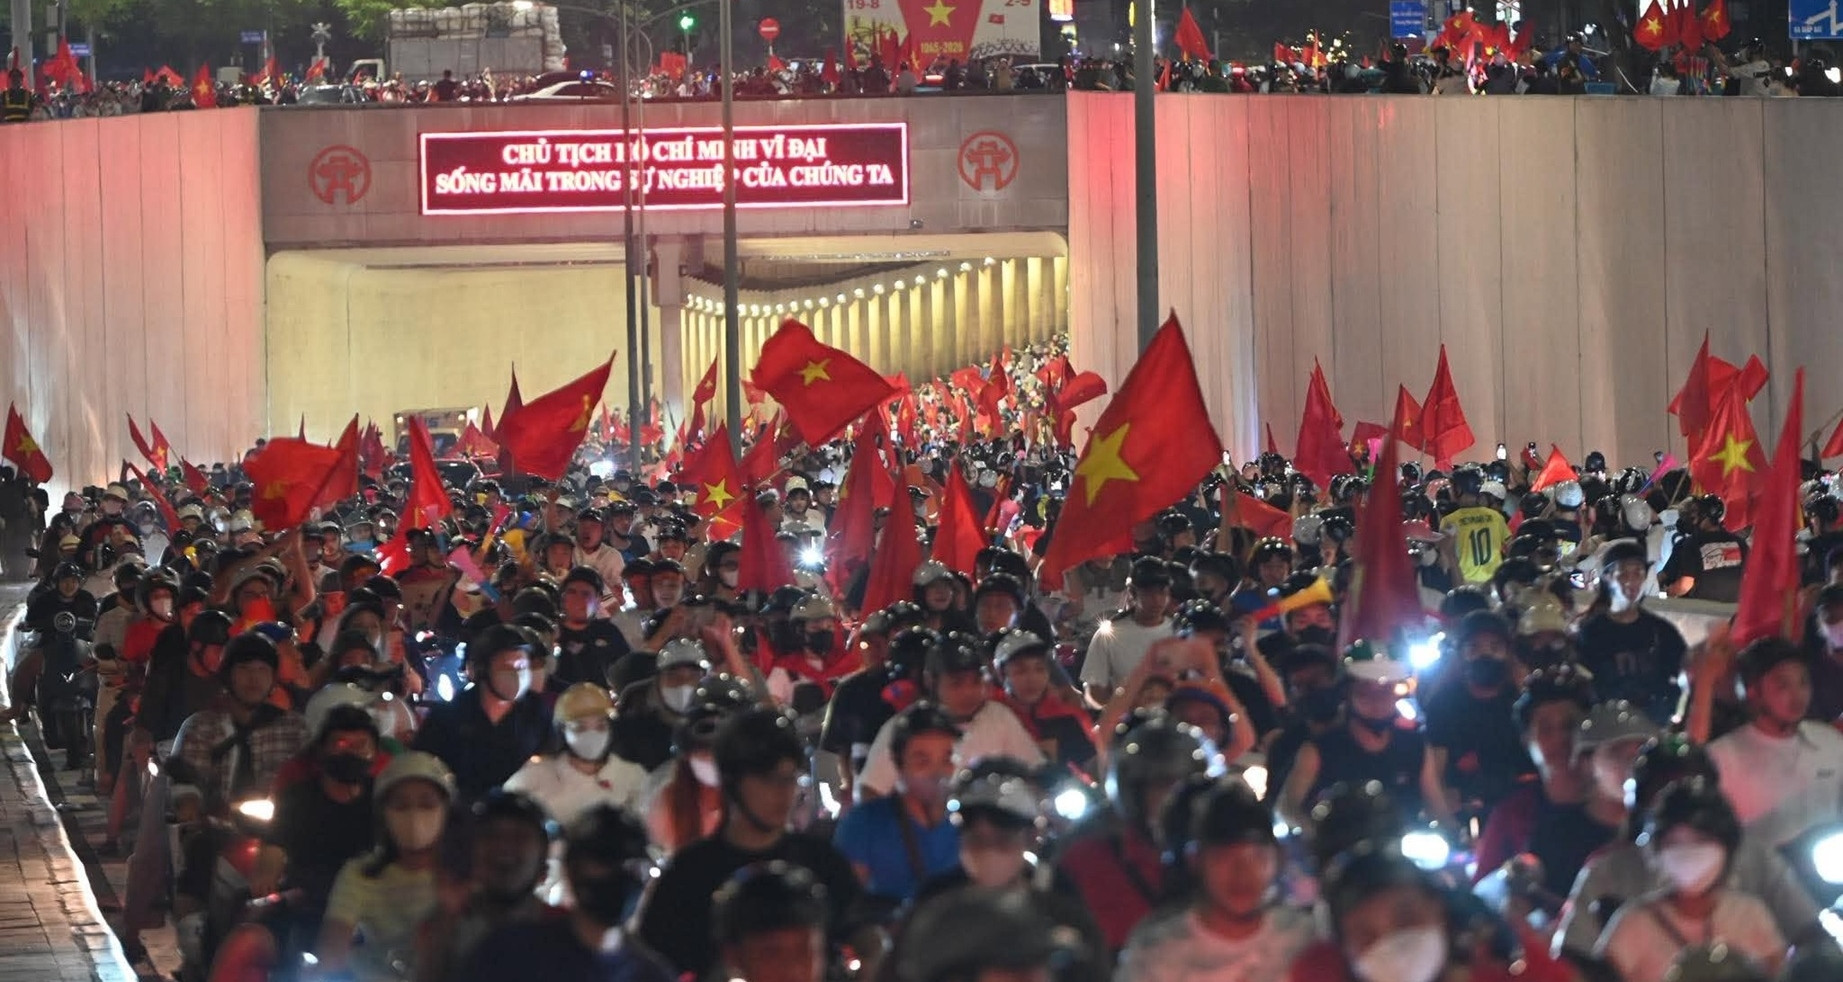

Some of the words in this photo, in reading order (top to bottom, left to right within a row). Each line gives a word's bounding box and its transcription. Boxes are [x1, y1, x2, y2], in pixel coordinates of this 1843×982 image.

[502, 137, 551, 164] CHỦ
[555, 143, 614, 167] TỊCH
[652, 136, 695, 161] CHÍ
[760, 134, 785, 159] VĨ
[788, 137, 827, 162] ĐẠI
[435, 165, 497, 194] SỐNG
[499, 167, 543, 192] MÃI
[545, 170, 621, 192] TRONG
[743, 161, 787, 187] CỦA
[789, 160, 864, 186] CHÚNG
[866, 164, 894, 184] TA
[1469, 527, 1491, 566] 10
